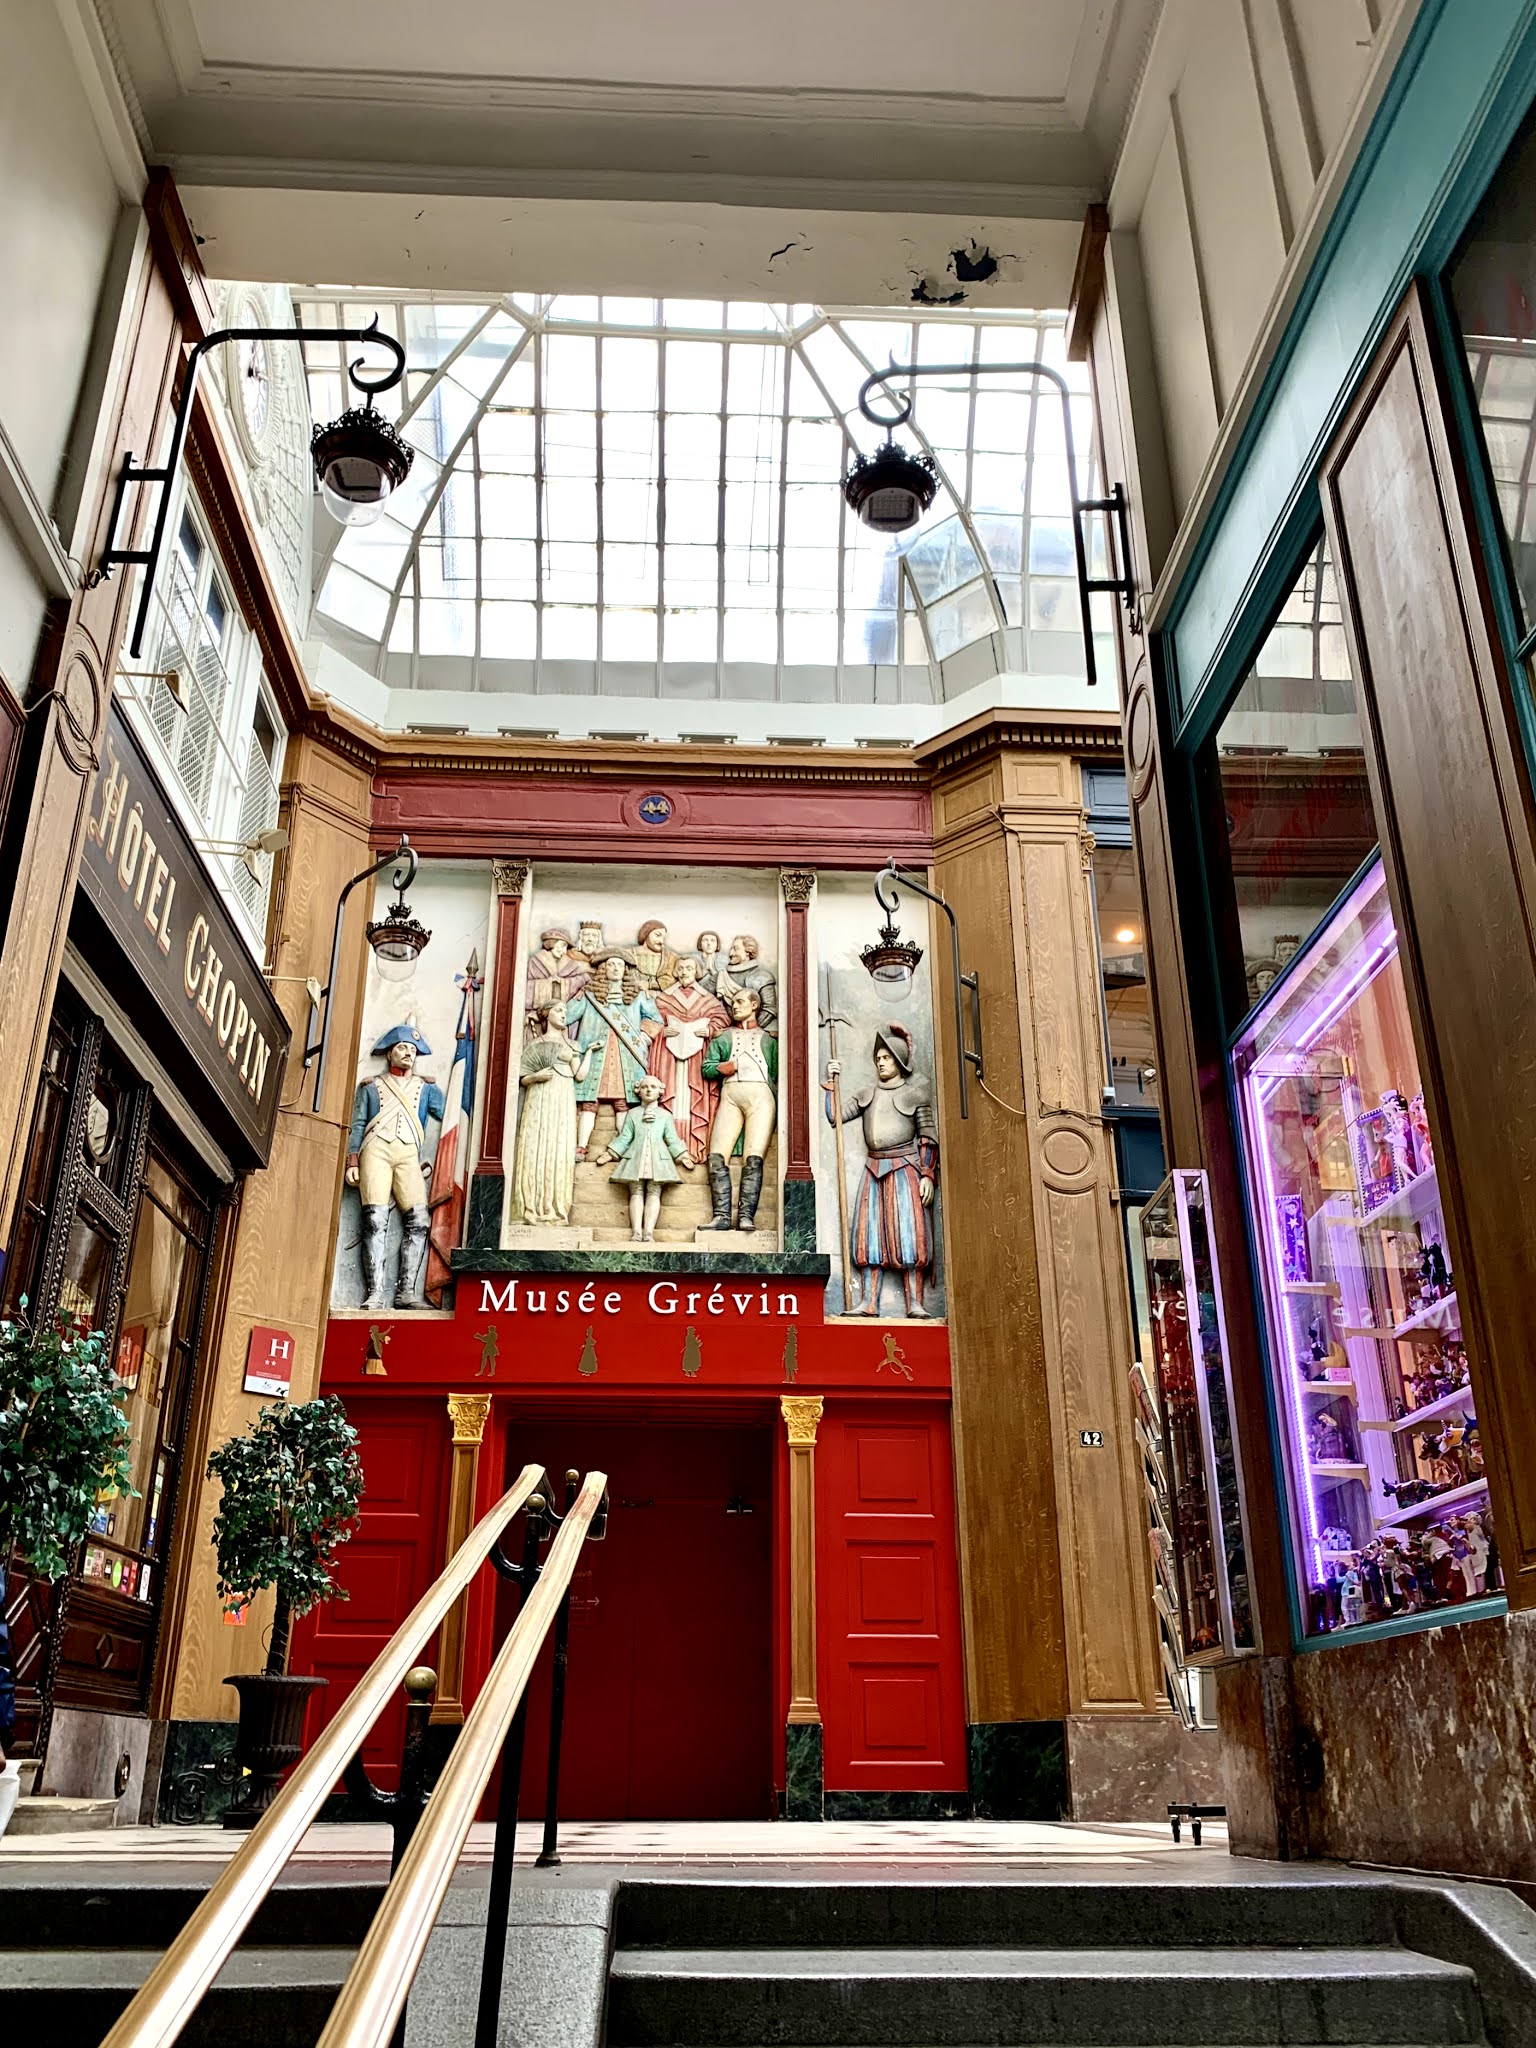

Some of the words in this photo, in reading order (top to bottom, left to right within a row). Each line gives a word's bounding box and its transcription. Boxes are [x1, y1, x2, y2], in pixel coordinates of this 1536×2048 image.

[642, 801, 669, 815] 44
[88, 733, 176, 957] HÔTEL
[184, 912, 271, 1106] CHOPIN
[478, 1280, 622, 1313] Musée
[648, 1281, 800, 1315] Grévin
[268, 1337, 291, 1360] H
[1083, 1432, 1101, 1445] 42
